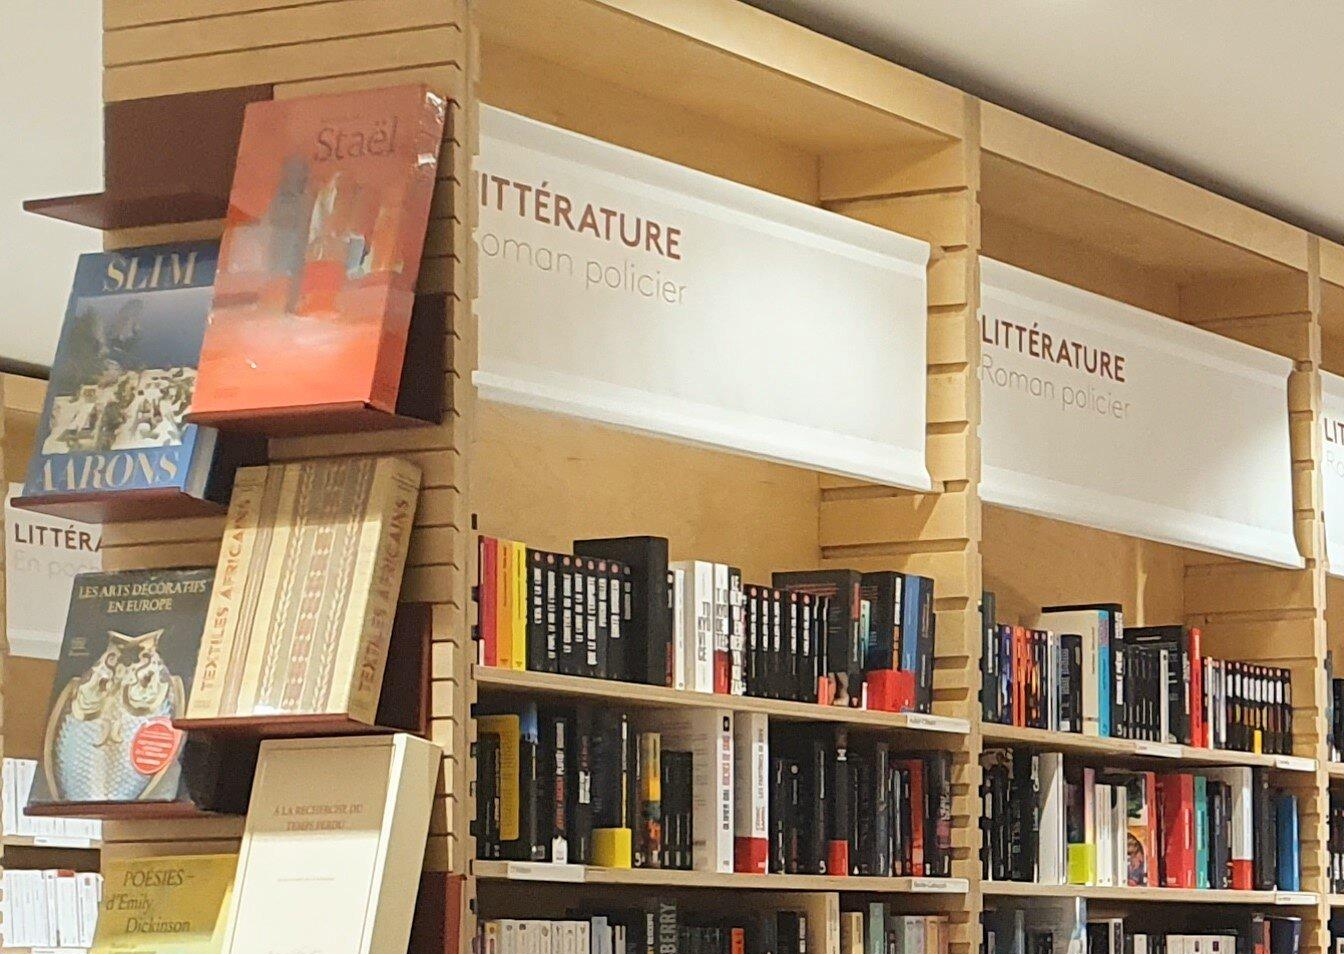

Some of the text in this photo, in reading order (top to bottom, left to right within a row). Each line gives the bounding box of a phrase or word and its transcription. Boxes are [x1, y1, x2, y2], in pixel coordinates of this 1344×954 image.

[314, 115, 399, 162] Staël
[481, 172, 682, 260] ITTÉRATURE
[102, 251, 199, 291] SLIM
[481, 233, 688, 304] oman policier
[981, 314, 1126, 383] LITTÉRATURE
[980, 353, 1131, 421] Roman policier
[40, 452, 182, 492] AARONS
[107, 598, 173, 613] EN EUROPE
[200, 611, 231, 692] TEXTILES
[105, 893, 154, 913] d'Emily
[125, 917, 191, 935] Dickinson
